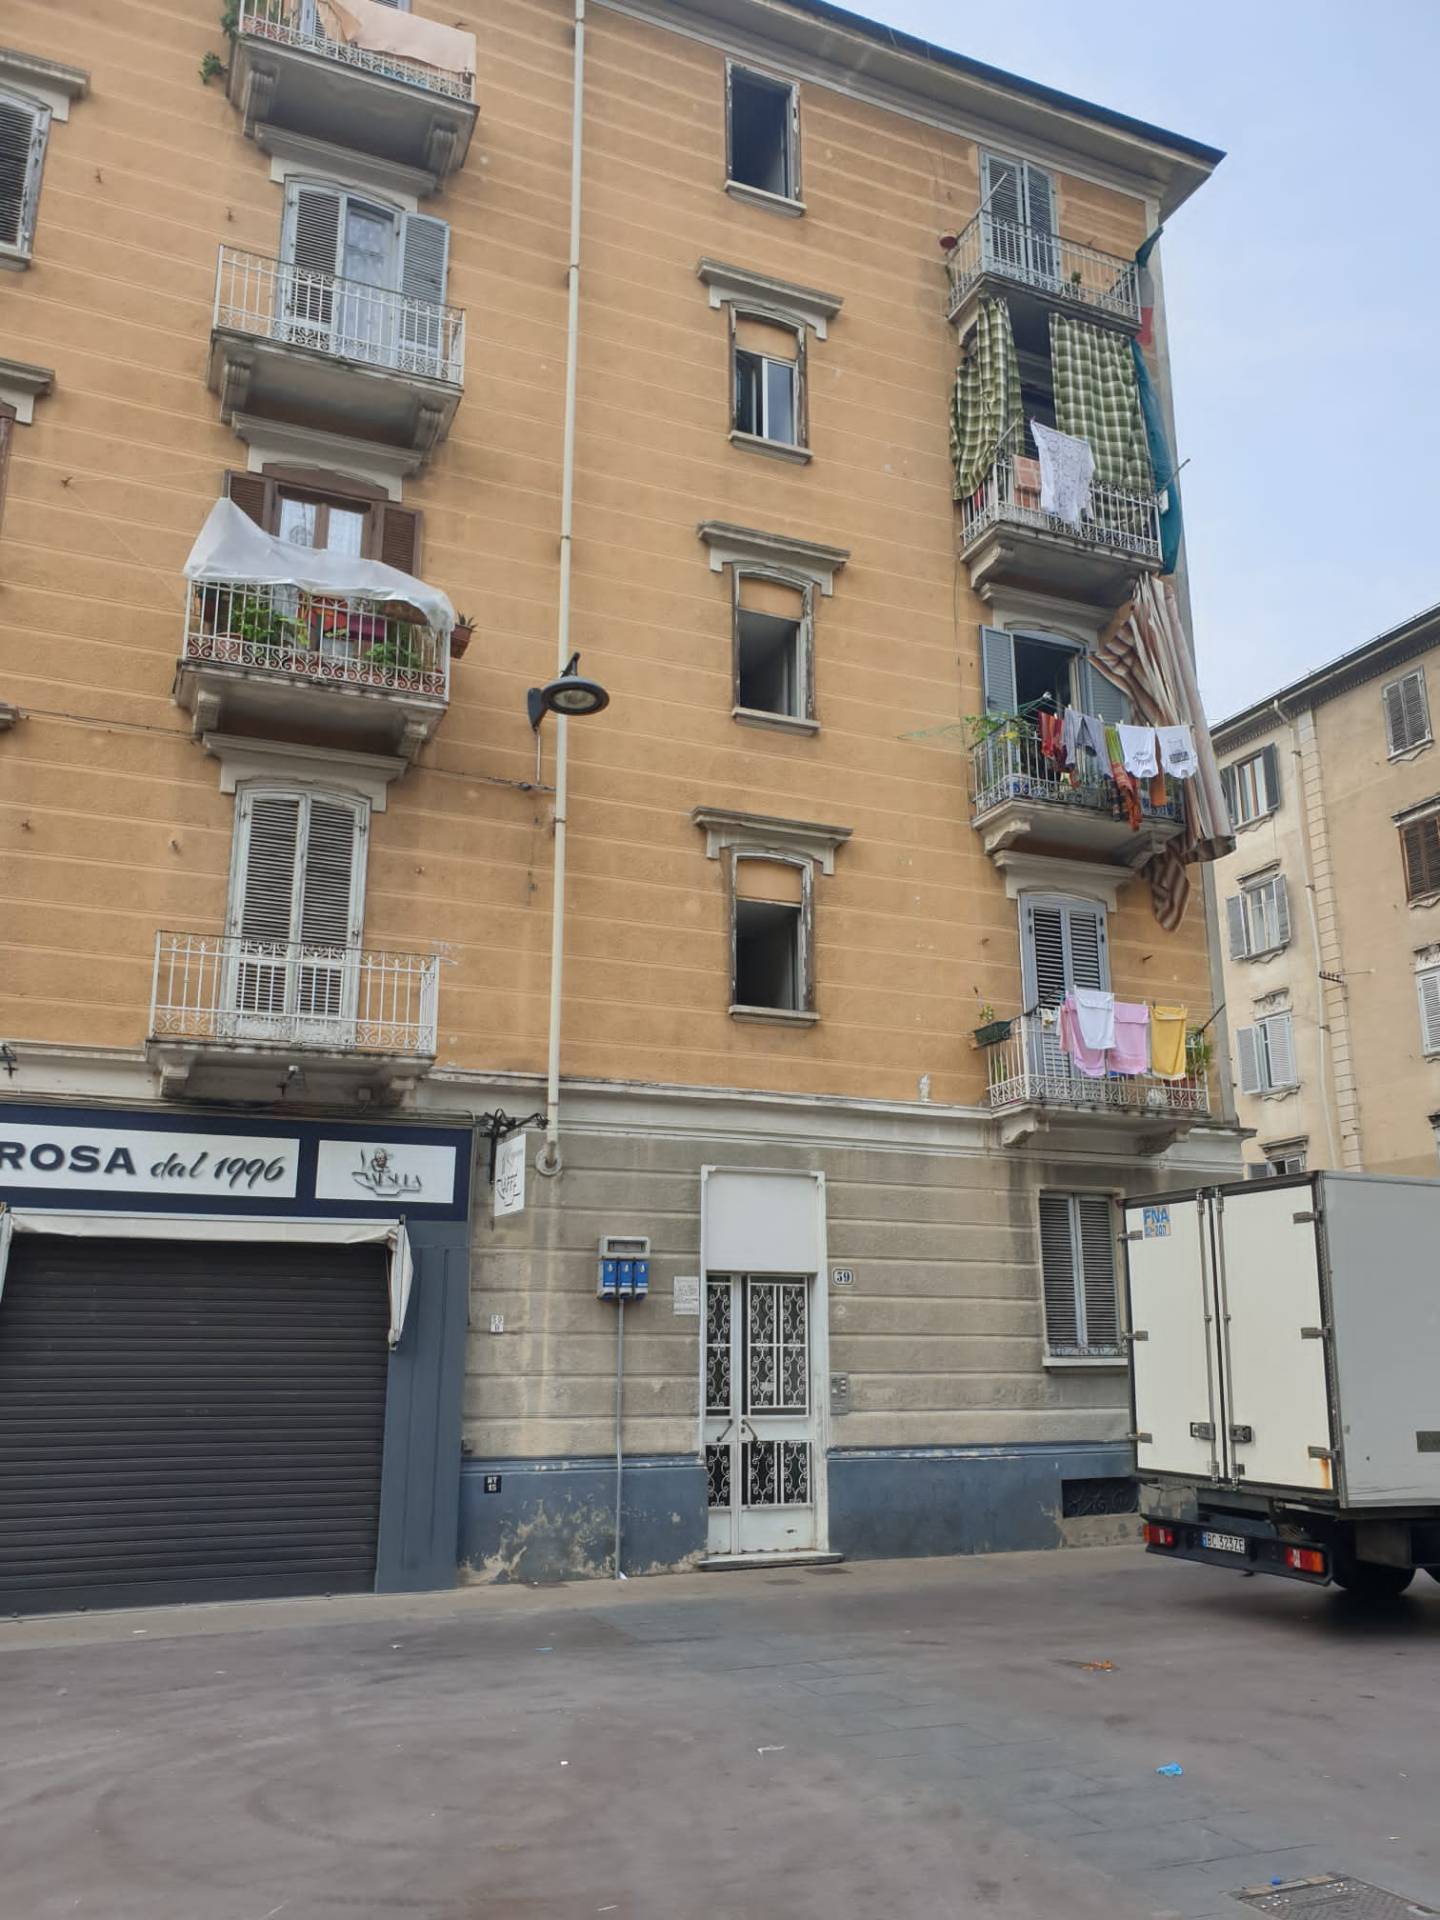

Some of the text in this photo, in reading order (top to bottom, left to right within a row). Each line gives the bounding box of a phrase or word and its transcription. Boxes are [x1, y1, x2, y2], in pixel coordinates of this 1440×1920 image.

[0, 1141, 286, 1189] ROSA dal 1996
[1143, 1206, 1169, 1224] FNA
